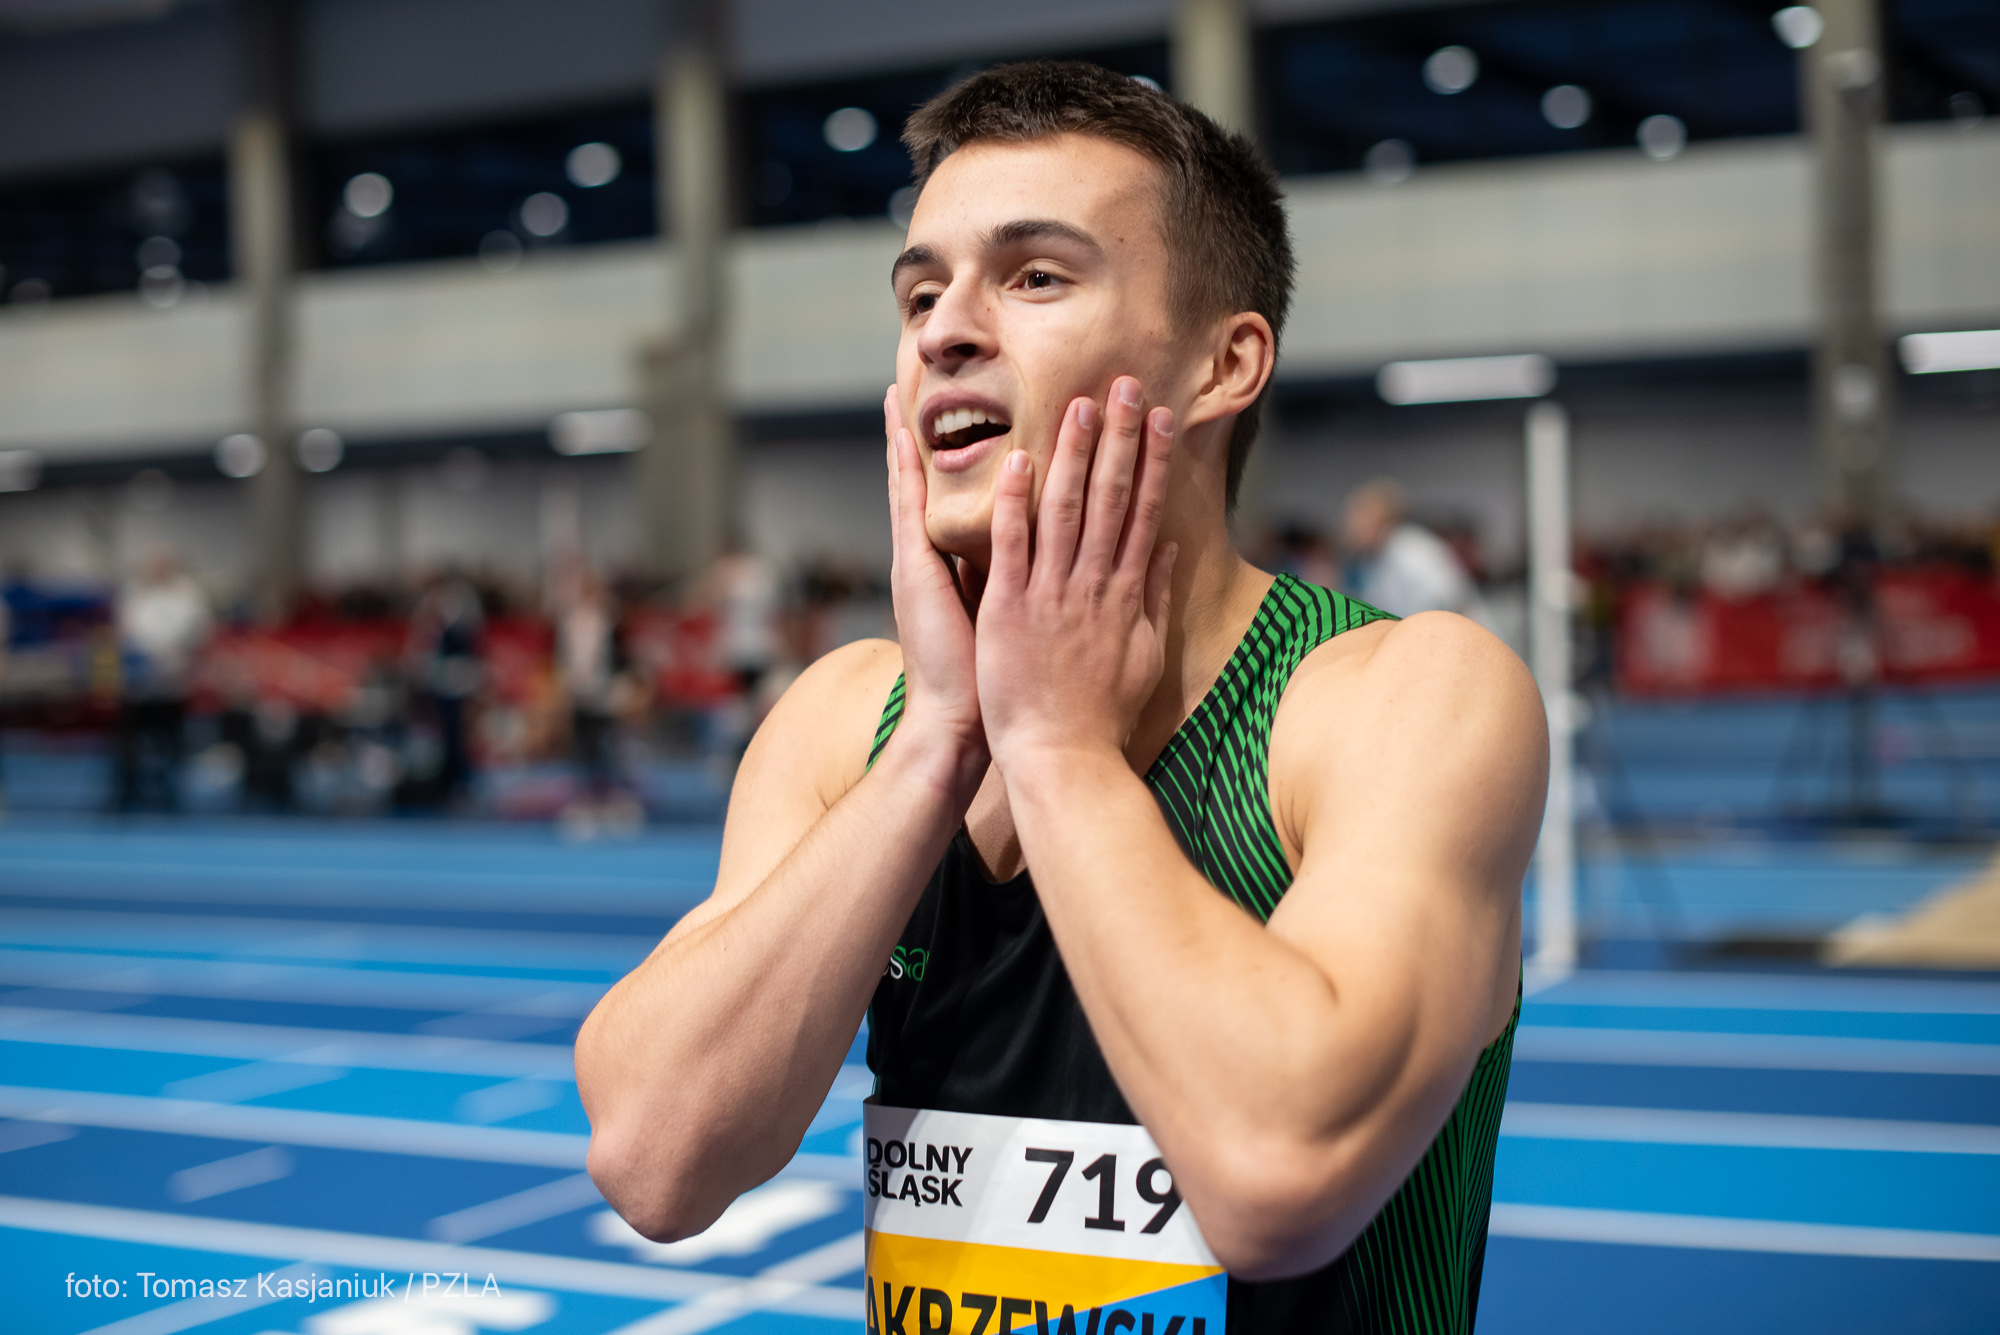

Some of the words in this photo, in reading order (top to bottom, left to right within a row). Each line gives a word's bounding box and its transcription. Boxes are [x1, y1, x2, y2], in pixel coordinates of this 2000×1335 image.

[867, 1137, 974, 1175] DOLNY
[868, 1163, 963, 1207] ŚLĄSK
[1024, 1147, 1185, 1234] 719
